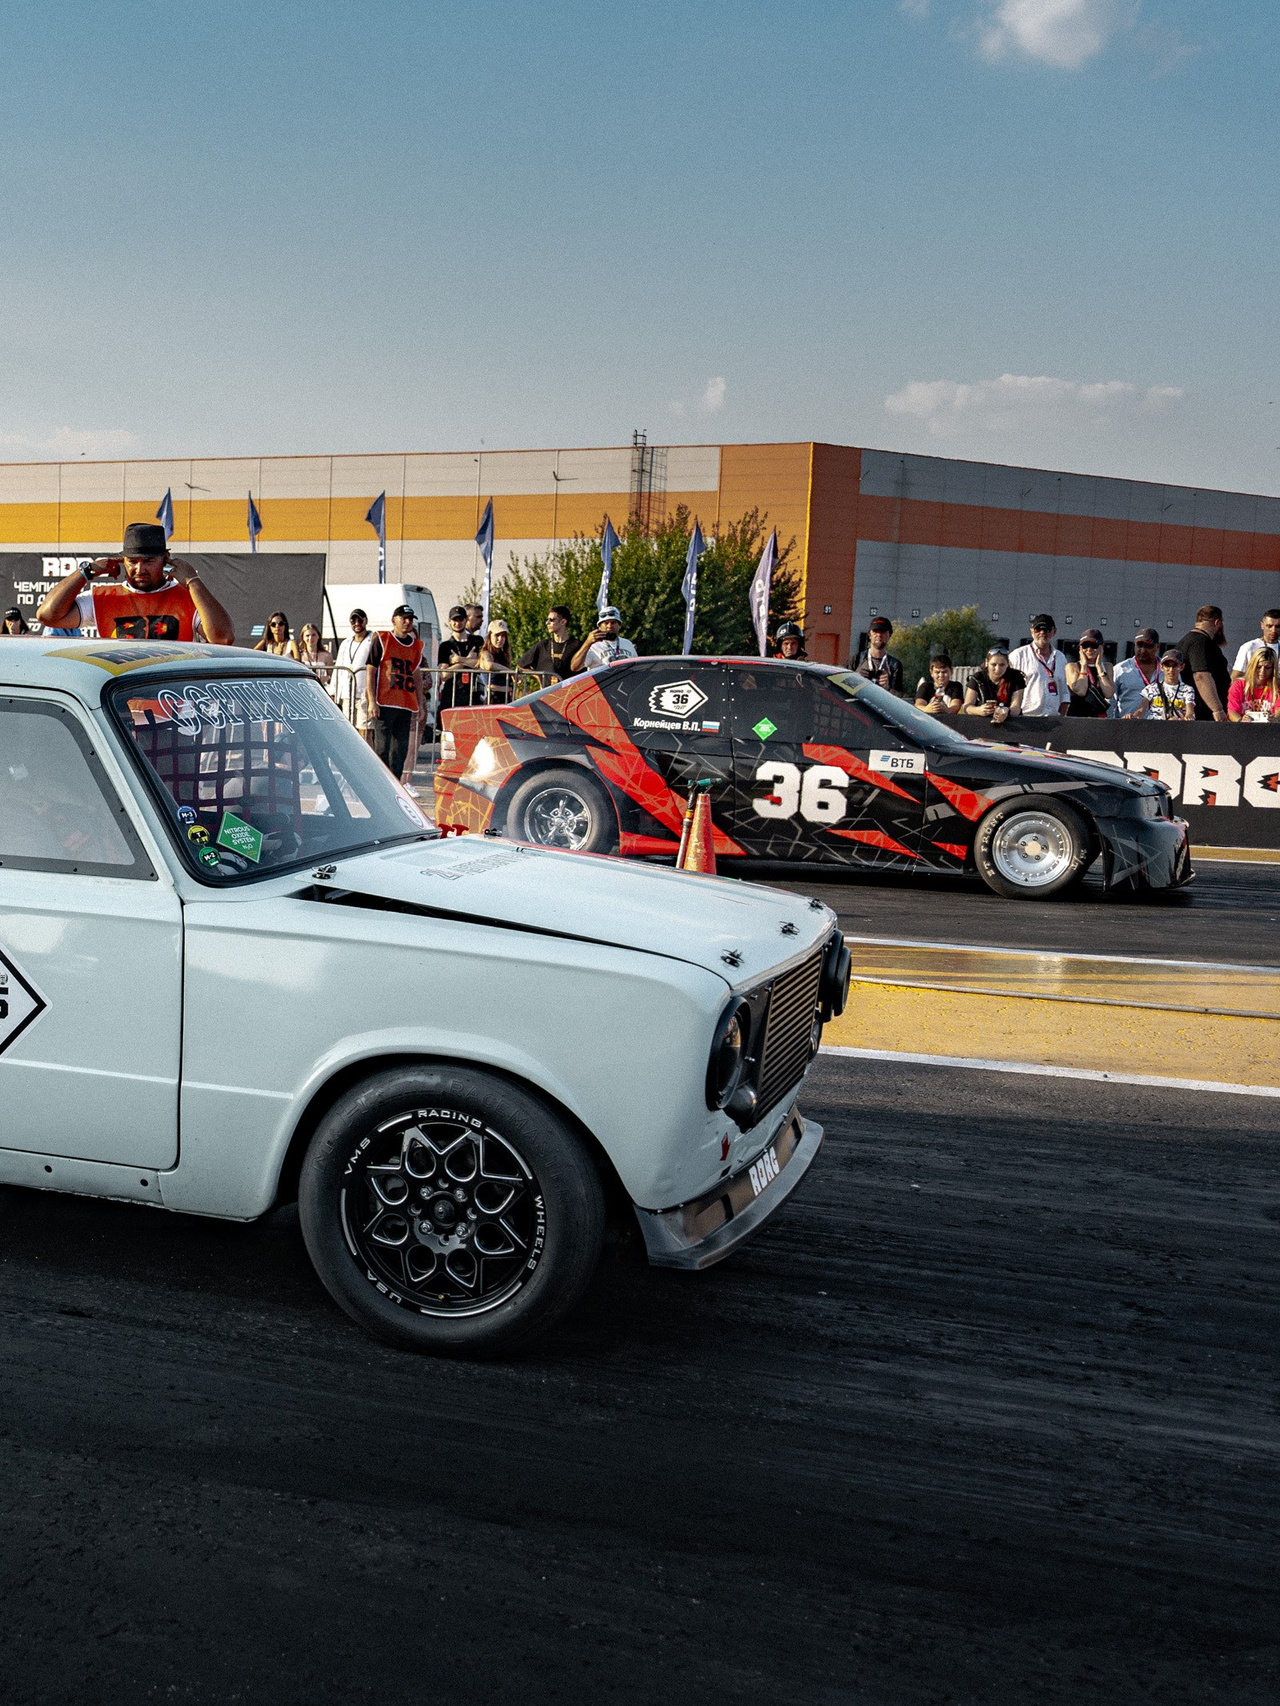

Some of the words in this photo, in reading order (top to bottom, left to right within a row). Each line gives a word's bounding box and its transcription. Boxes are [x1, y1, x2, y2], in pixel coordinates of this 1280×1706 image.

[17, 594, 34, 605] ПО
[672, 694, 689, 705] 36
[633, 717, 681, 730] Корнейцев
[682, 721, 701, 731] В.П.
[890, 757, 914, 769] ВТБ
[1066, 750, 1280, 809] DRC
[752, 760, 850, 825] 36
[223, 825, 251, 834] NITROUS
[231, 831, 250, 839] OXIDE
[981, 811, 1004, 853] FRONT
[231, 836, 256, 845] SYSTEM
[417, 1109, 482, 1129] RACING
[344, 1137, 371, 1175] VMS
[748, 1146, 780, 1197] RDRC
[526, 1194, 545, 1271] WHEELS
[367, 1269, 402, 1304] USA
